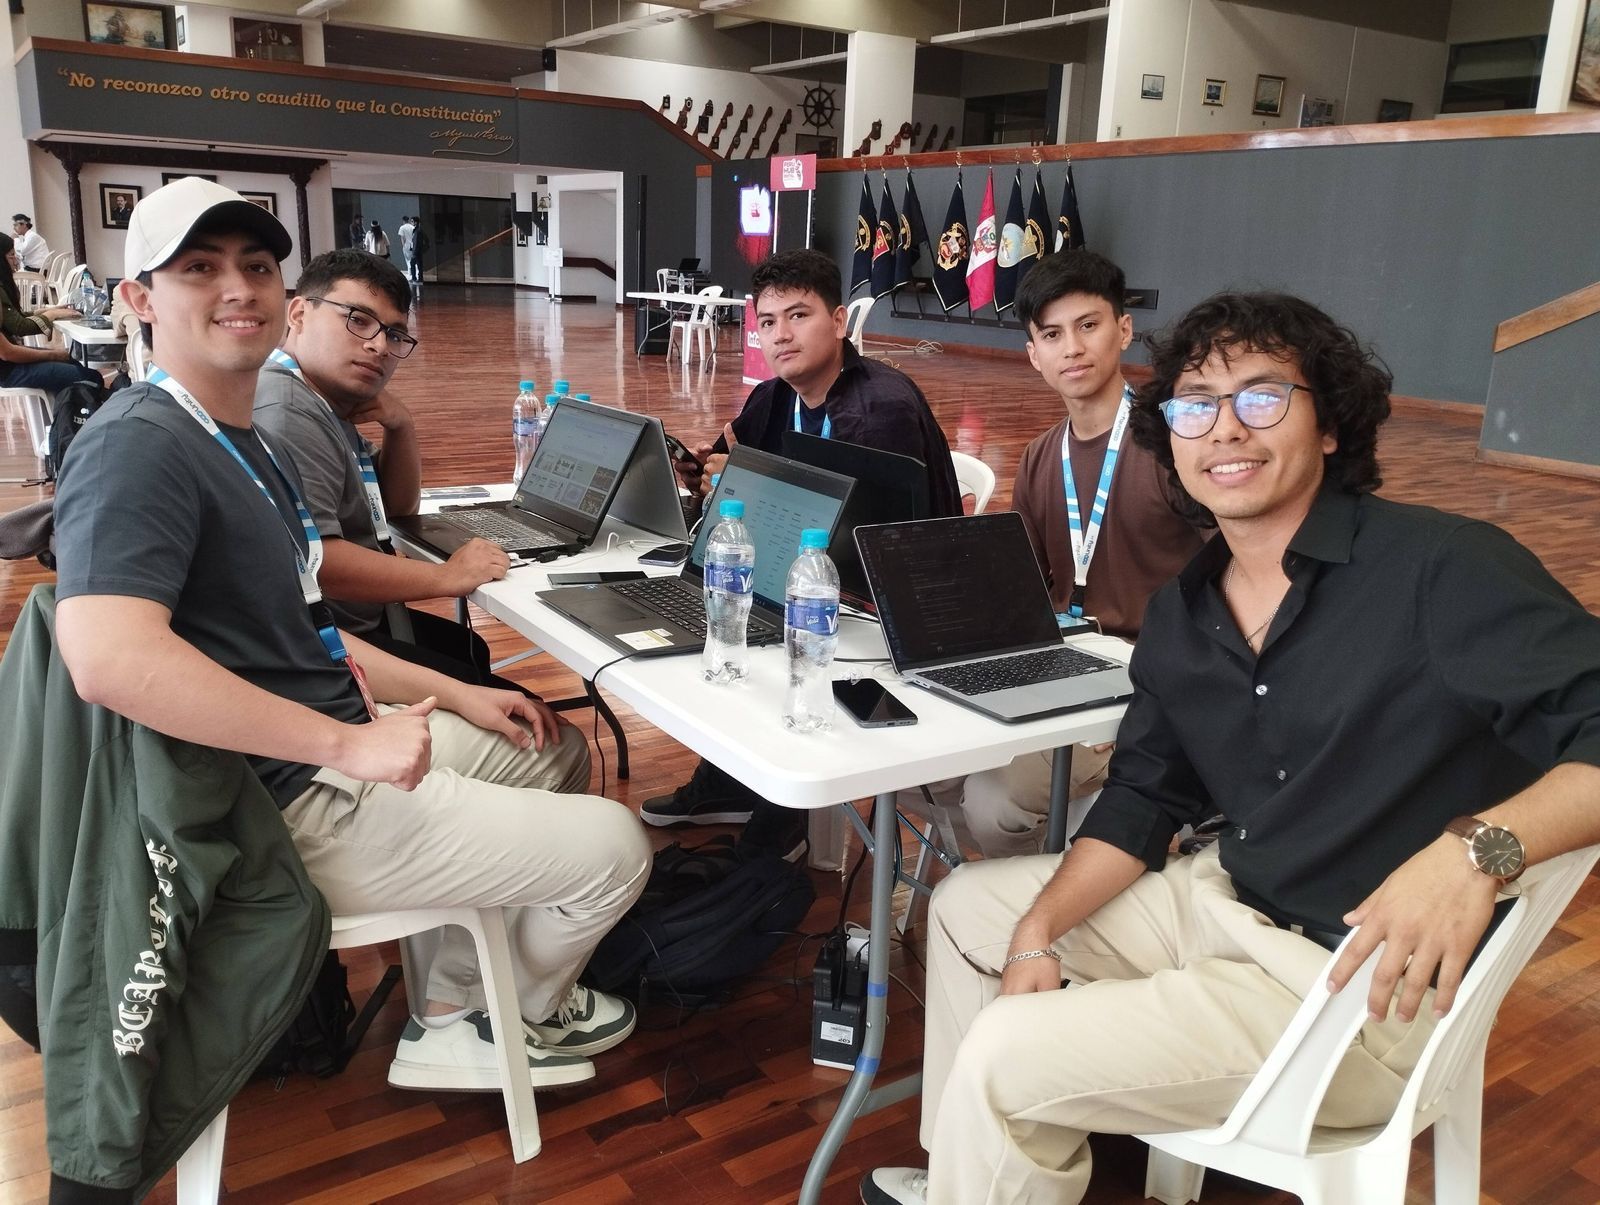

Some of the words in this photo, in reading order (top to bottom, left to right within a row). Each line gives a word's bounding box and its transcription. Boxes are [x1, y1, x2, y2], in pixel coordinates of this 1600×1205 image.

[103, 78, 203, 97] reconozco
[210, 86, 250, 102] otro
[256, 92, 331, 109] caudillo
[335, 99, 366, 114] que
[370, 100, 387, 114] la
[390, 102, 502, 124] Constitución”
